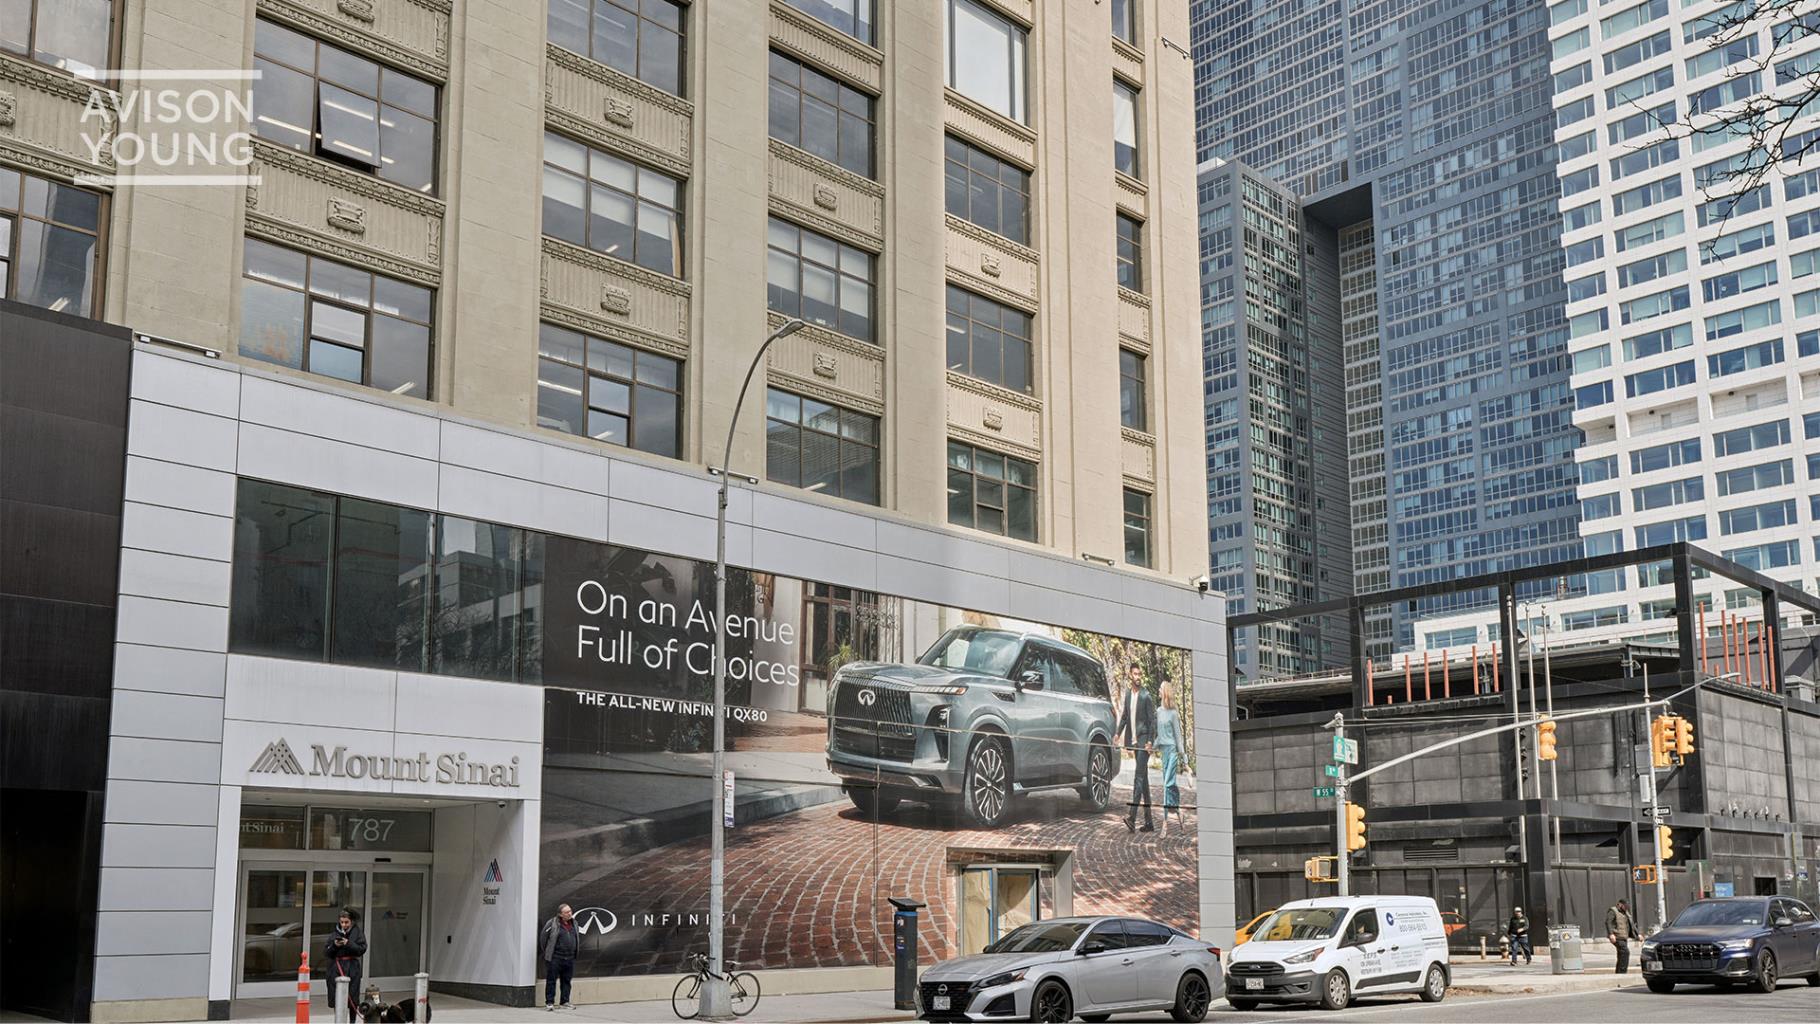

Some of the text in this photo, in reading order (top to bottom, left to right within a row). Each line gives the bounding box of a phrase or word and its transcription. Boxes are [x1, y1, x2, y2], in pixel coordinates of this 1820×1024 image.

[576, 580, 628, 619] On
[638, 600, 676, 627] an
[577, 624, 632, 665] Full
[643, 638, 678, 670] of
[576, 691, 768, 723] THE ALL-NEW INFINI QX80
[309, 744, 521, 788] Mount Sinai
[251, 821, 285, 833] Sinai
[350, 818, 395, 842] 787
[631, 913, 737, 926] INFINII
